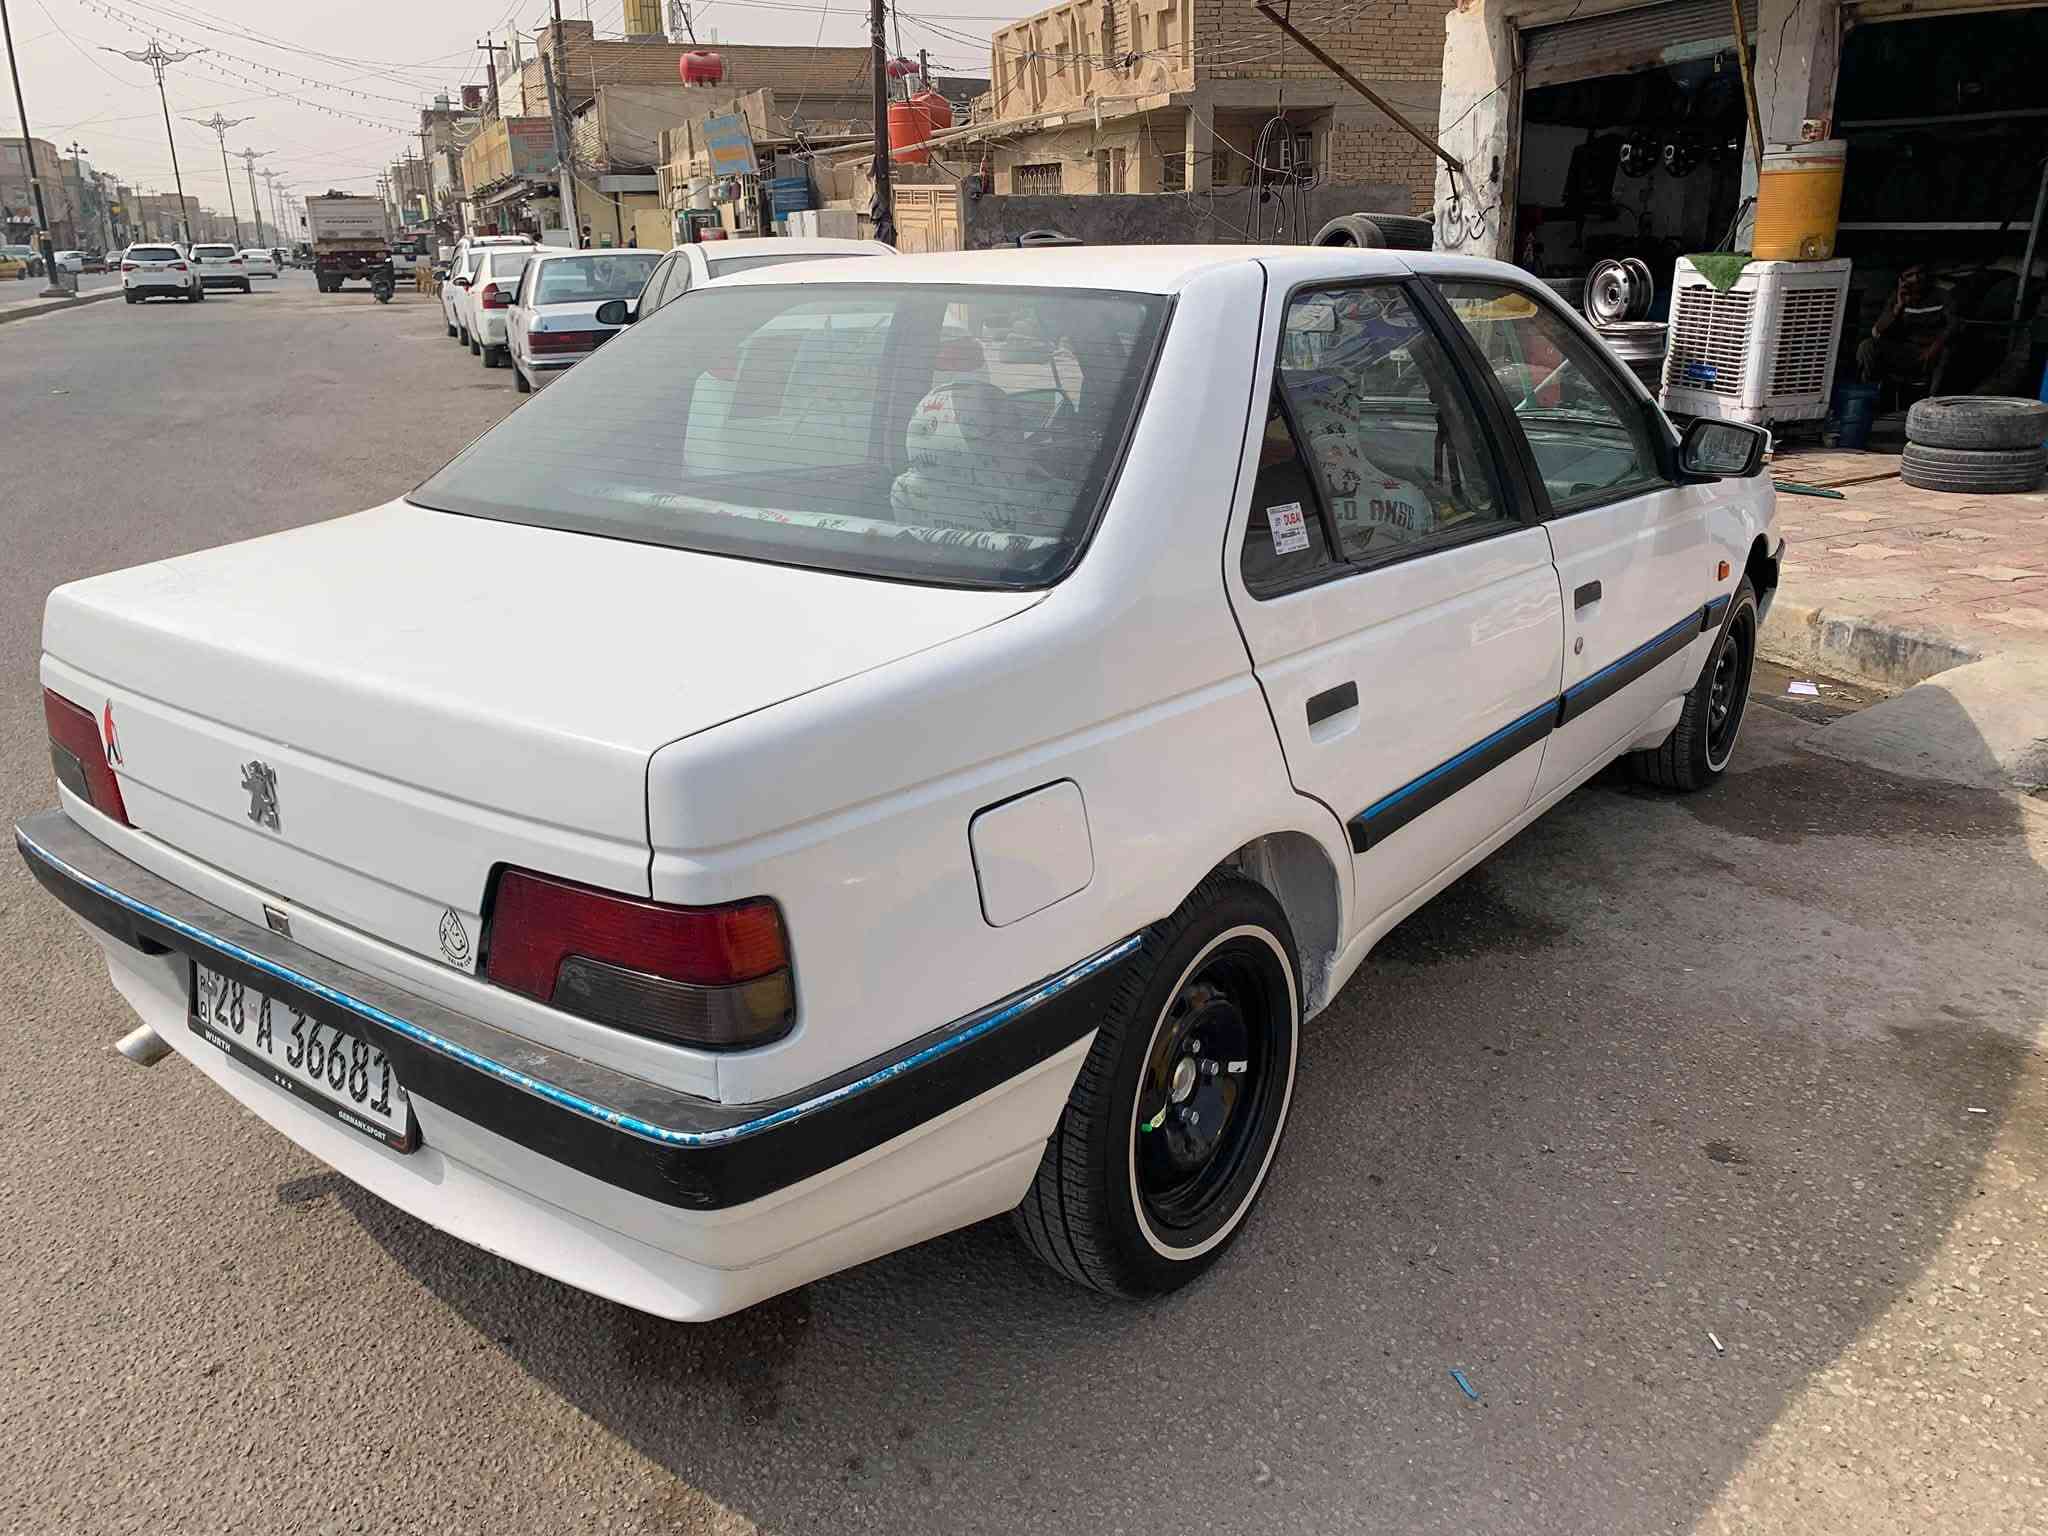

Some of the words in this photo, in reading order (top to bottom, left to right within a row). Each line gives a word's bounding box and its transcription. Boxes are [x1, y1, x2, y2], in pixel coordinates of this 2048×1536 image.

[214, 973, 245, 1035] 28
[257, 995, 273, 1054] A
[286, 1005, 392, 1118] 36681
